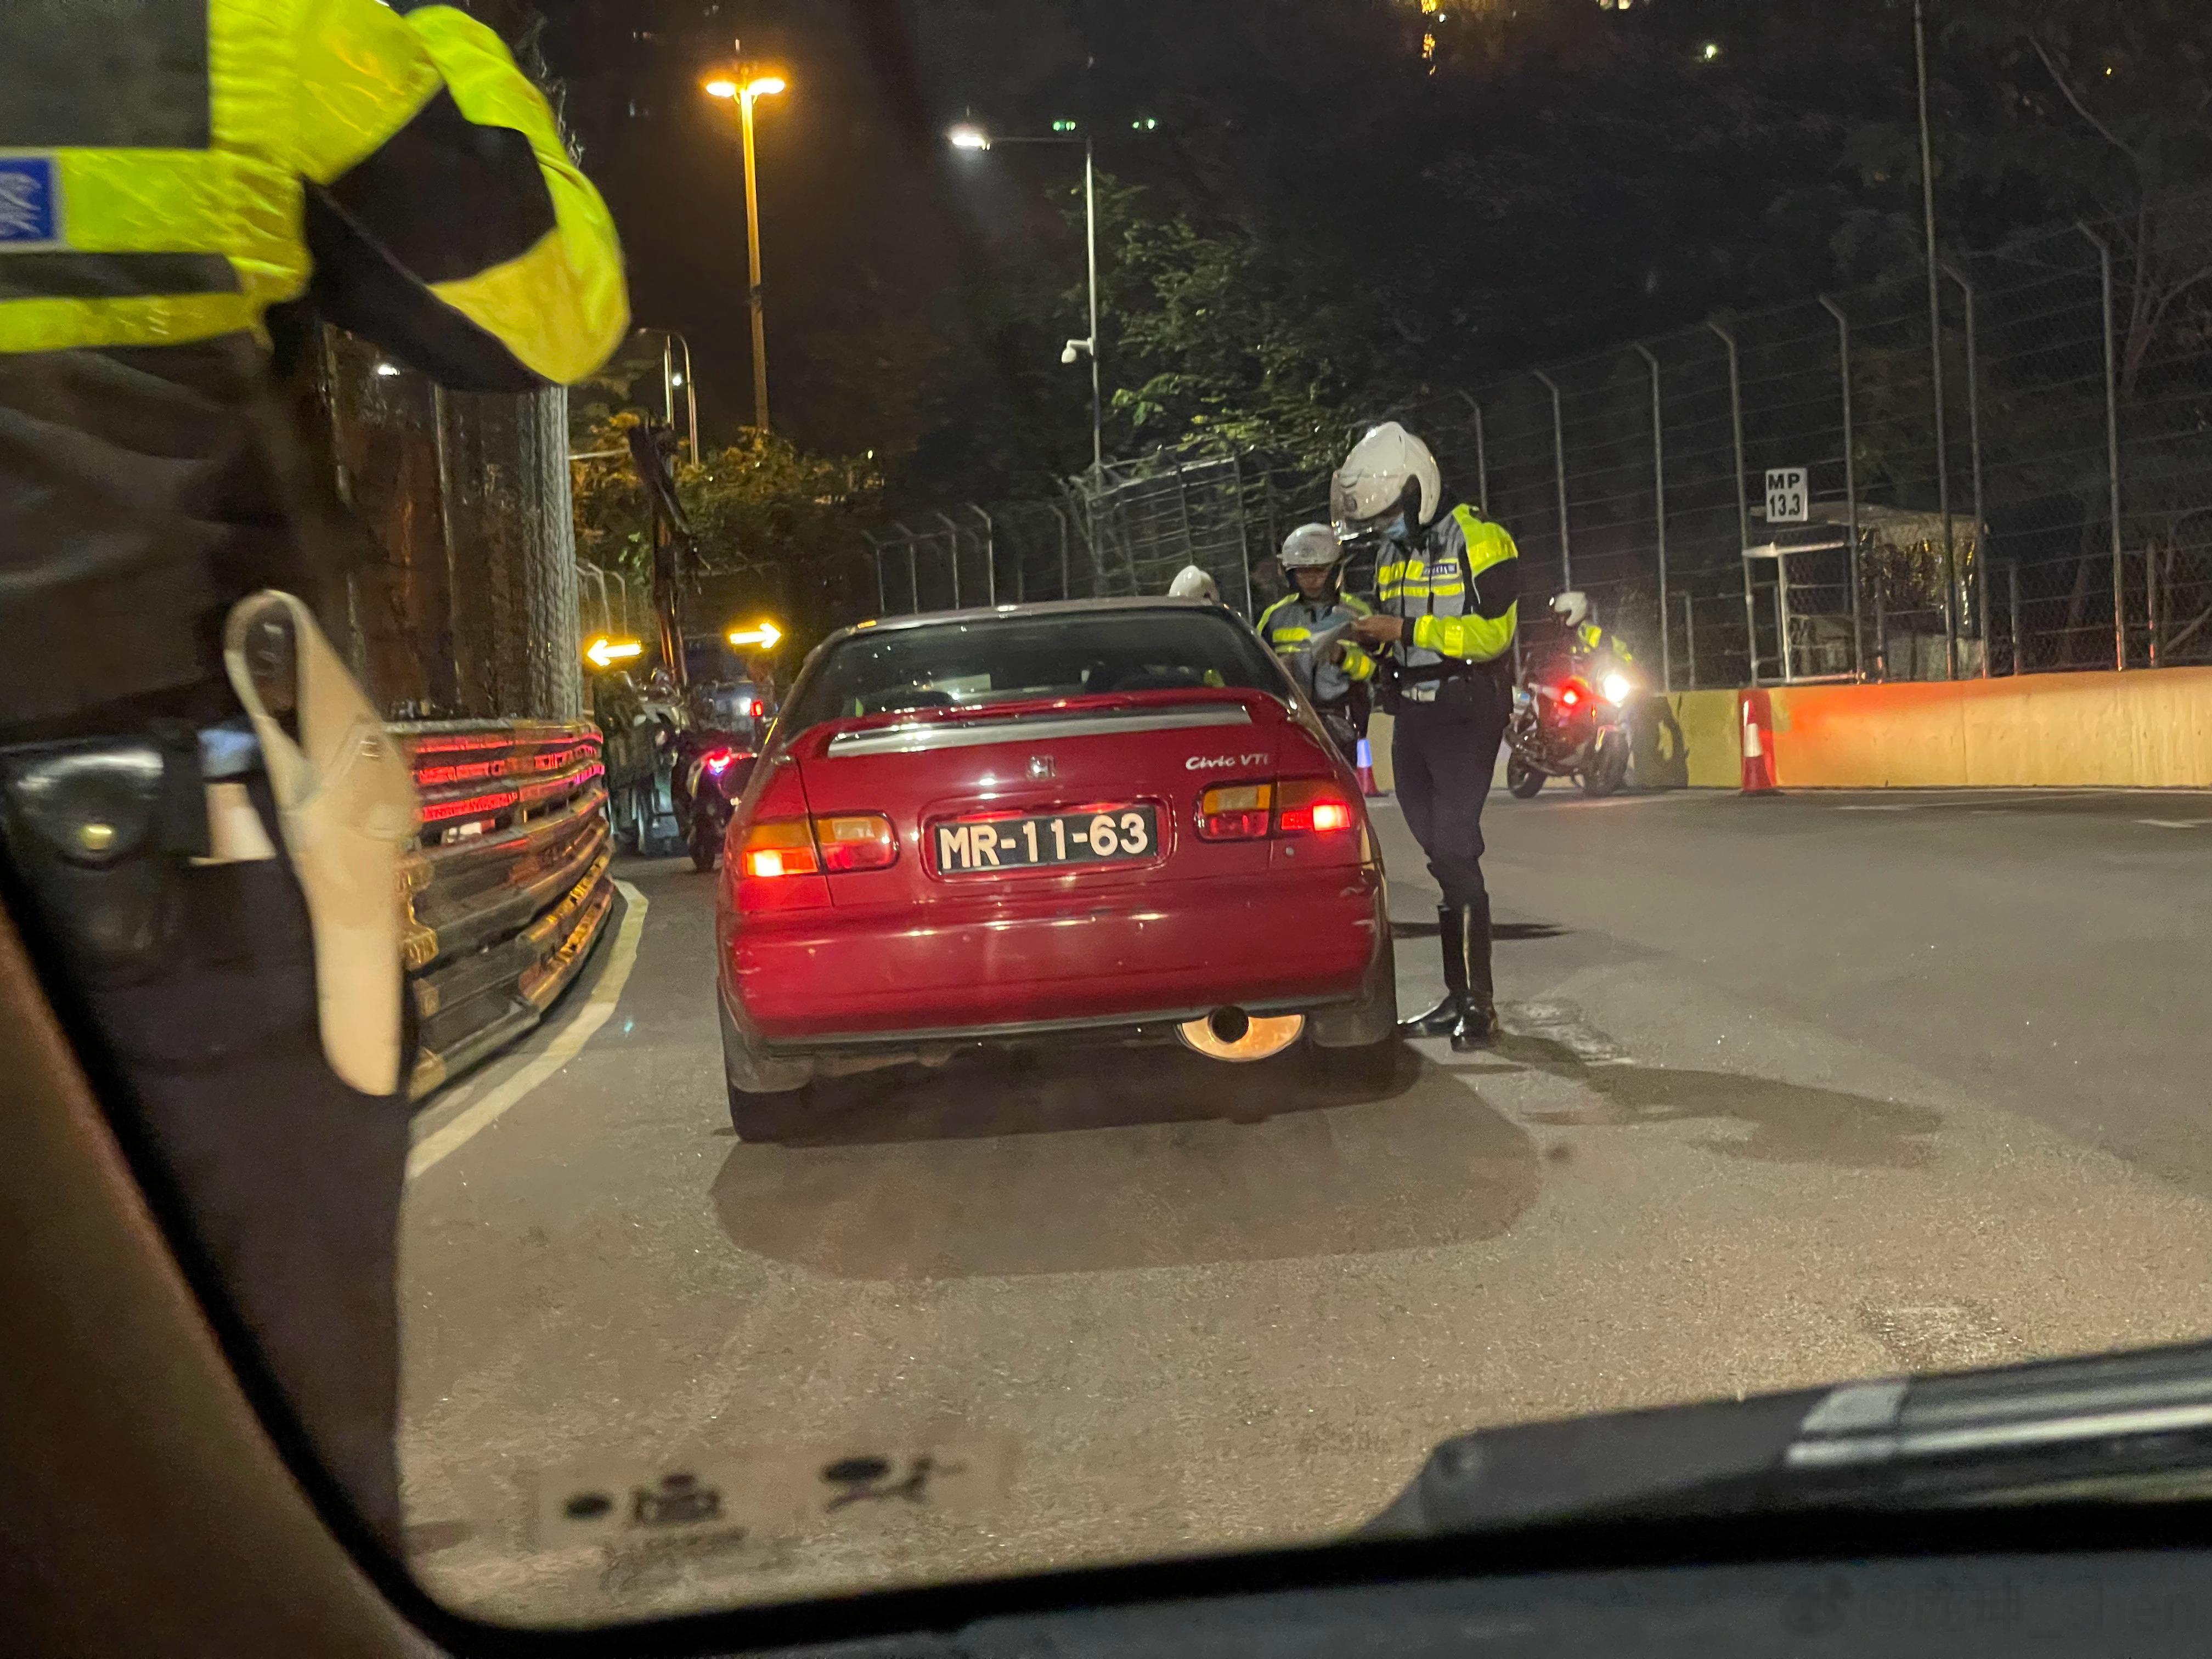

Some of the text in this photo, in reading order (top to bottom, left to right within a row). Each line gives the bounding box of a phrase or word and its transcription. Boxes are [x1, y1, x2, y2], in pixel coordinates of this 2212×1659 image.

[1768, 473, 1800, 490] MP
[1185, 755, 1236, 771] Civic
[939, 812, 1149, 870] MR-11-63
